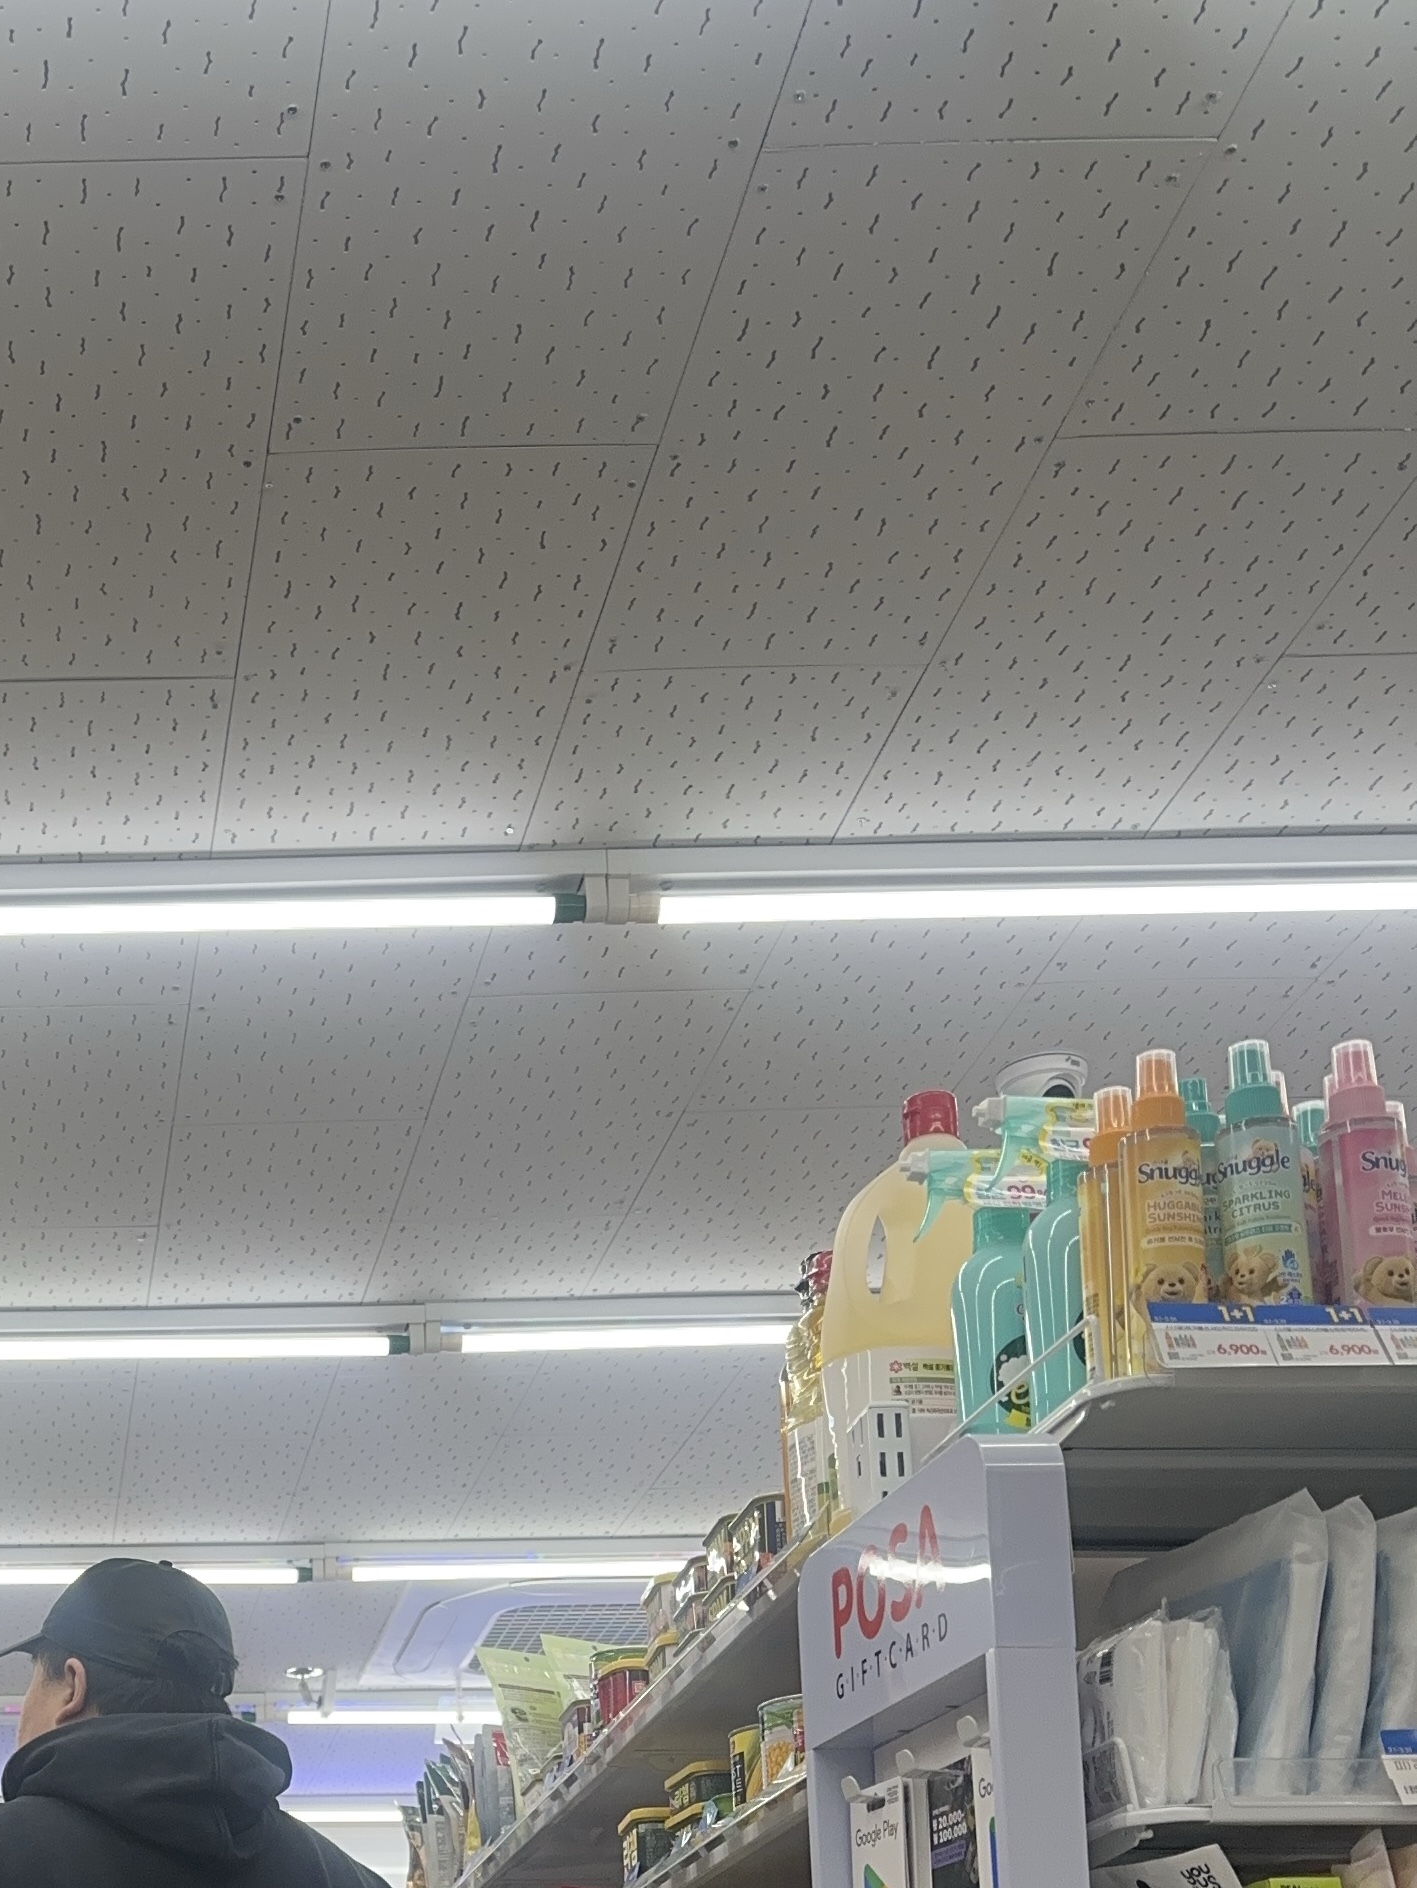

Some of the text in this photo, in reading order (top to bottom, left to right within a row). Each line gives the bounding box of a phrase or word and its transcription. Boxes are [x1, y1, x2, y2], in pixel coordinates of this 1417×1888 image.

[1218, 1152, 1292, 1184] Snuggle
[831, 1504, 947, 1660] POSA
[855, 1819, 899, 1848] Google Play
